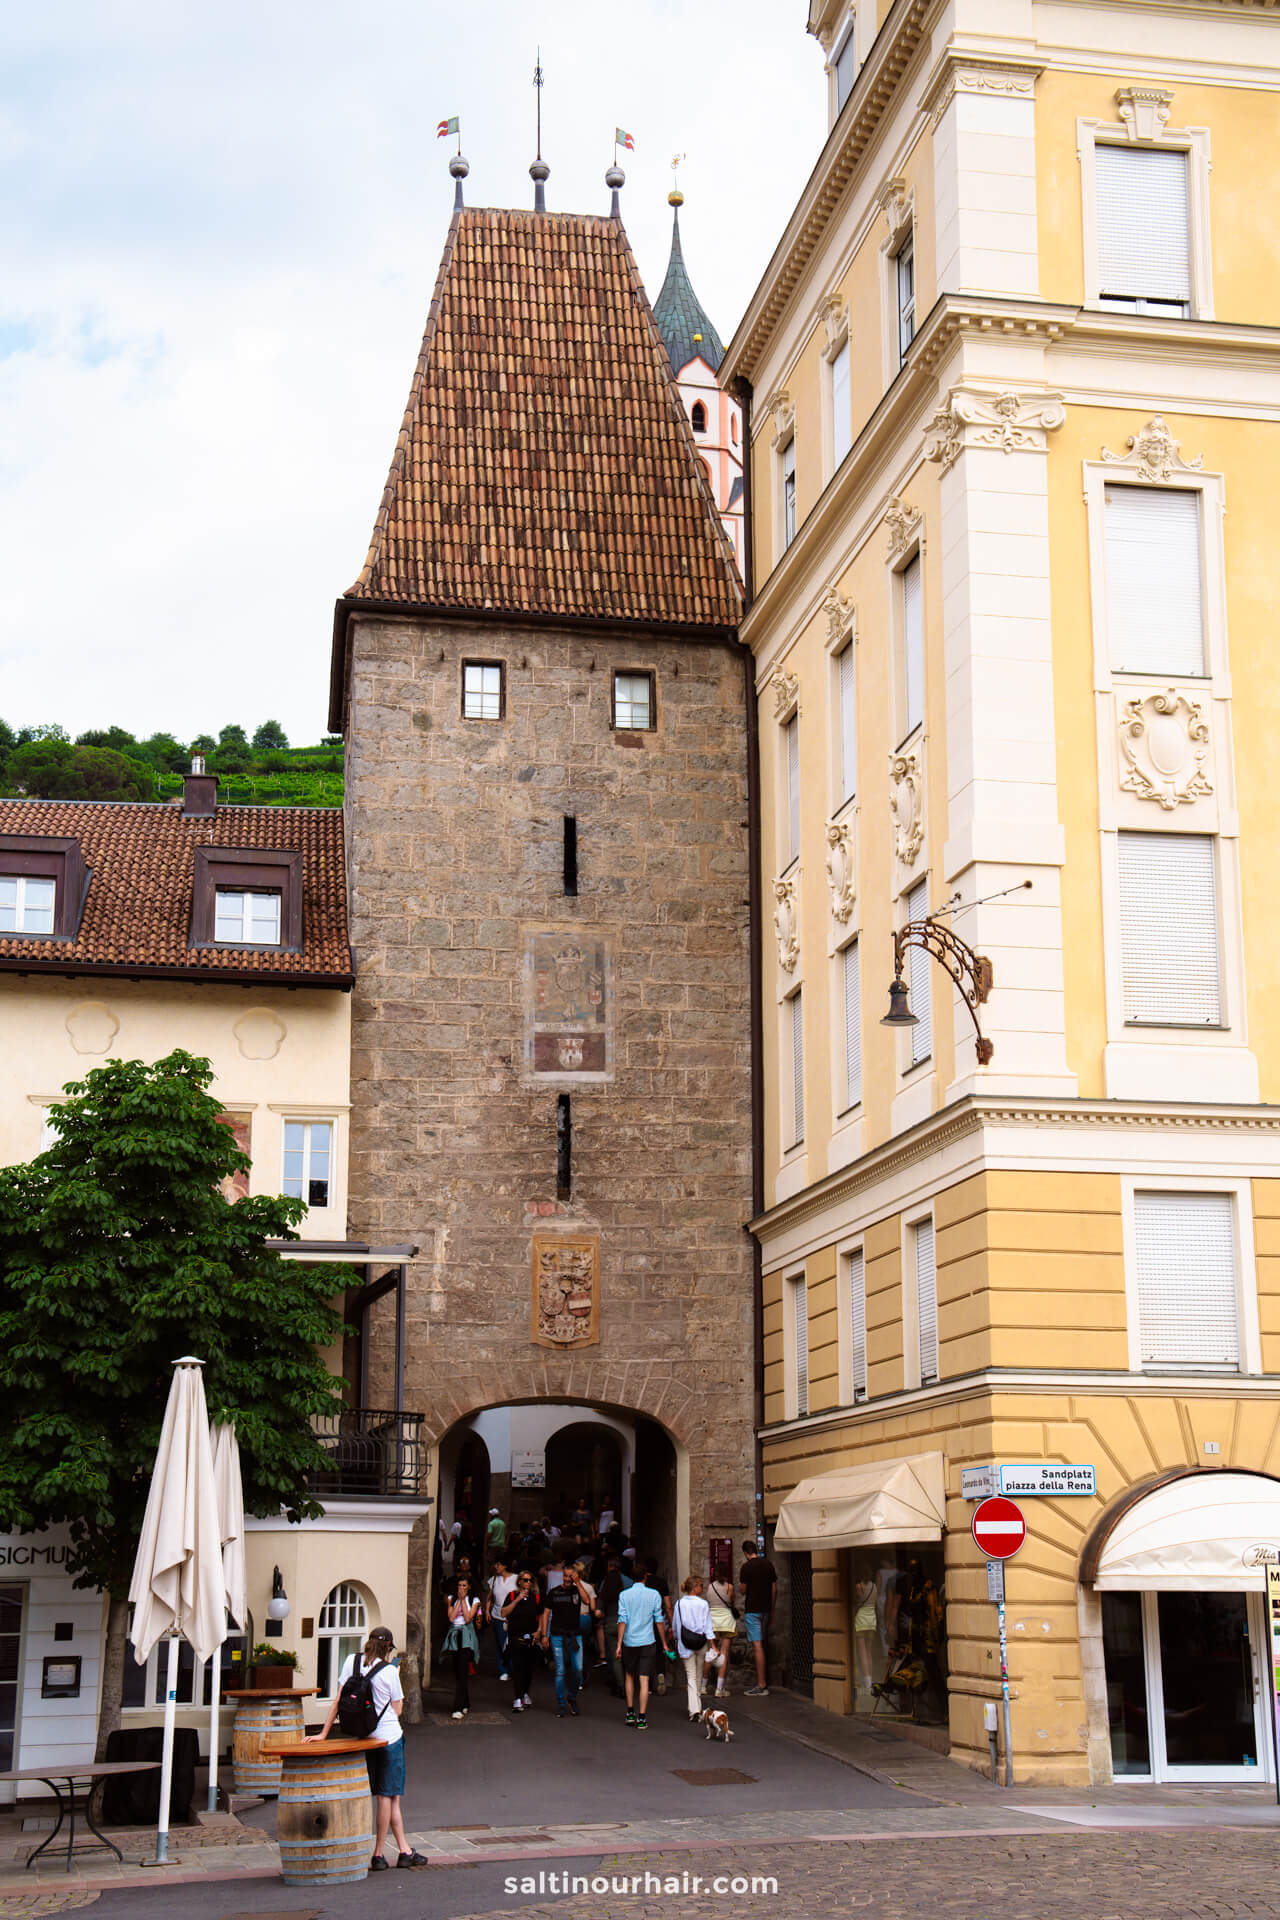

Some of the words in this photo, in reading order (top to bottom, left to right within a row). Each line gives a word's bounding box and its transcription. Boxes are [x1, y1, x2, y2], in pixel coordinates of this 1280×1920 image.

[1041, 1469, 1092, 1480] Sandplatz
[1006, 1481, 1036, 1491] piazza
[1039, 1481, 1064, 1490] della
[1067, 1481, 1092, 1490] Rena
[0, 1545, 82, 1565] SIGMUN
